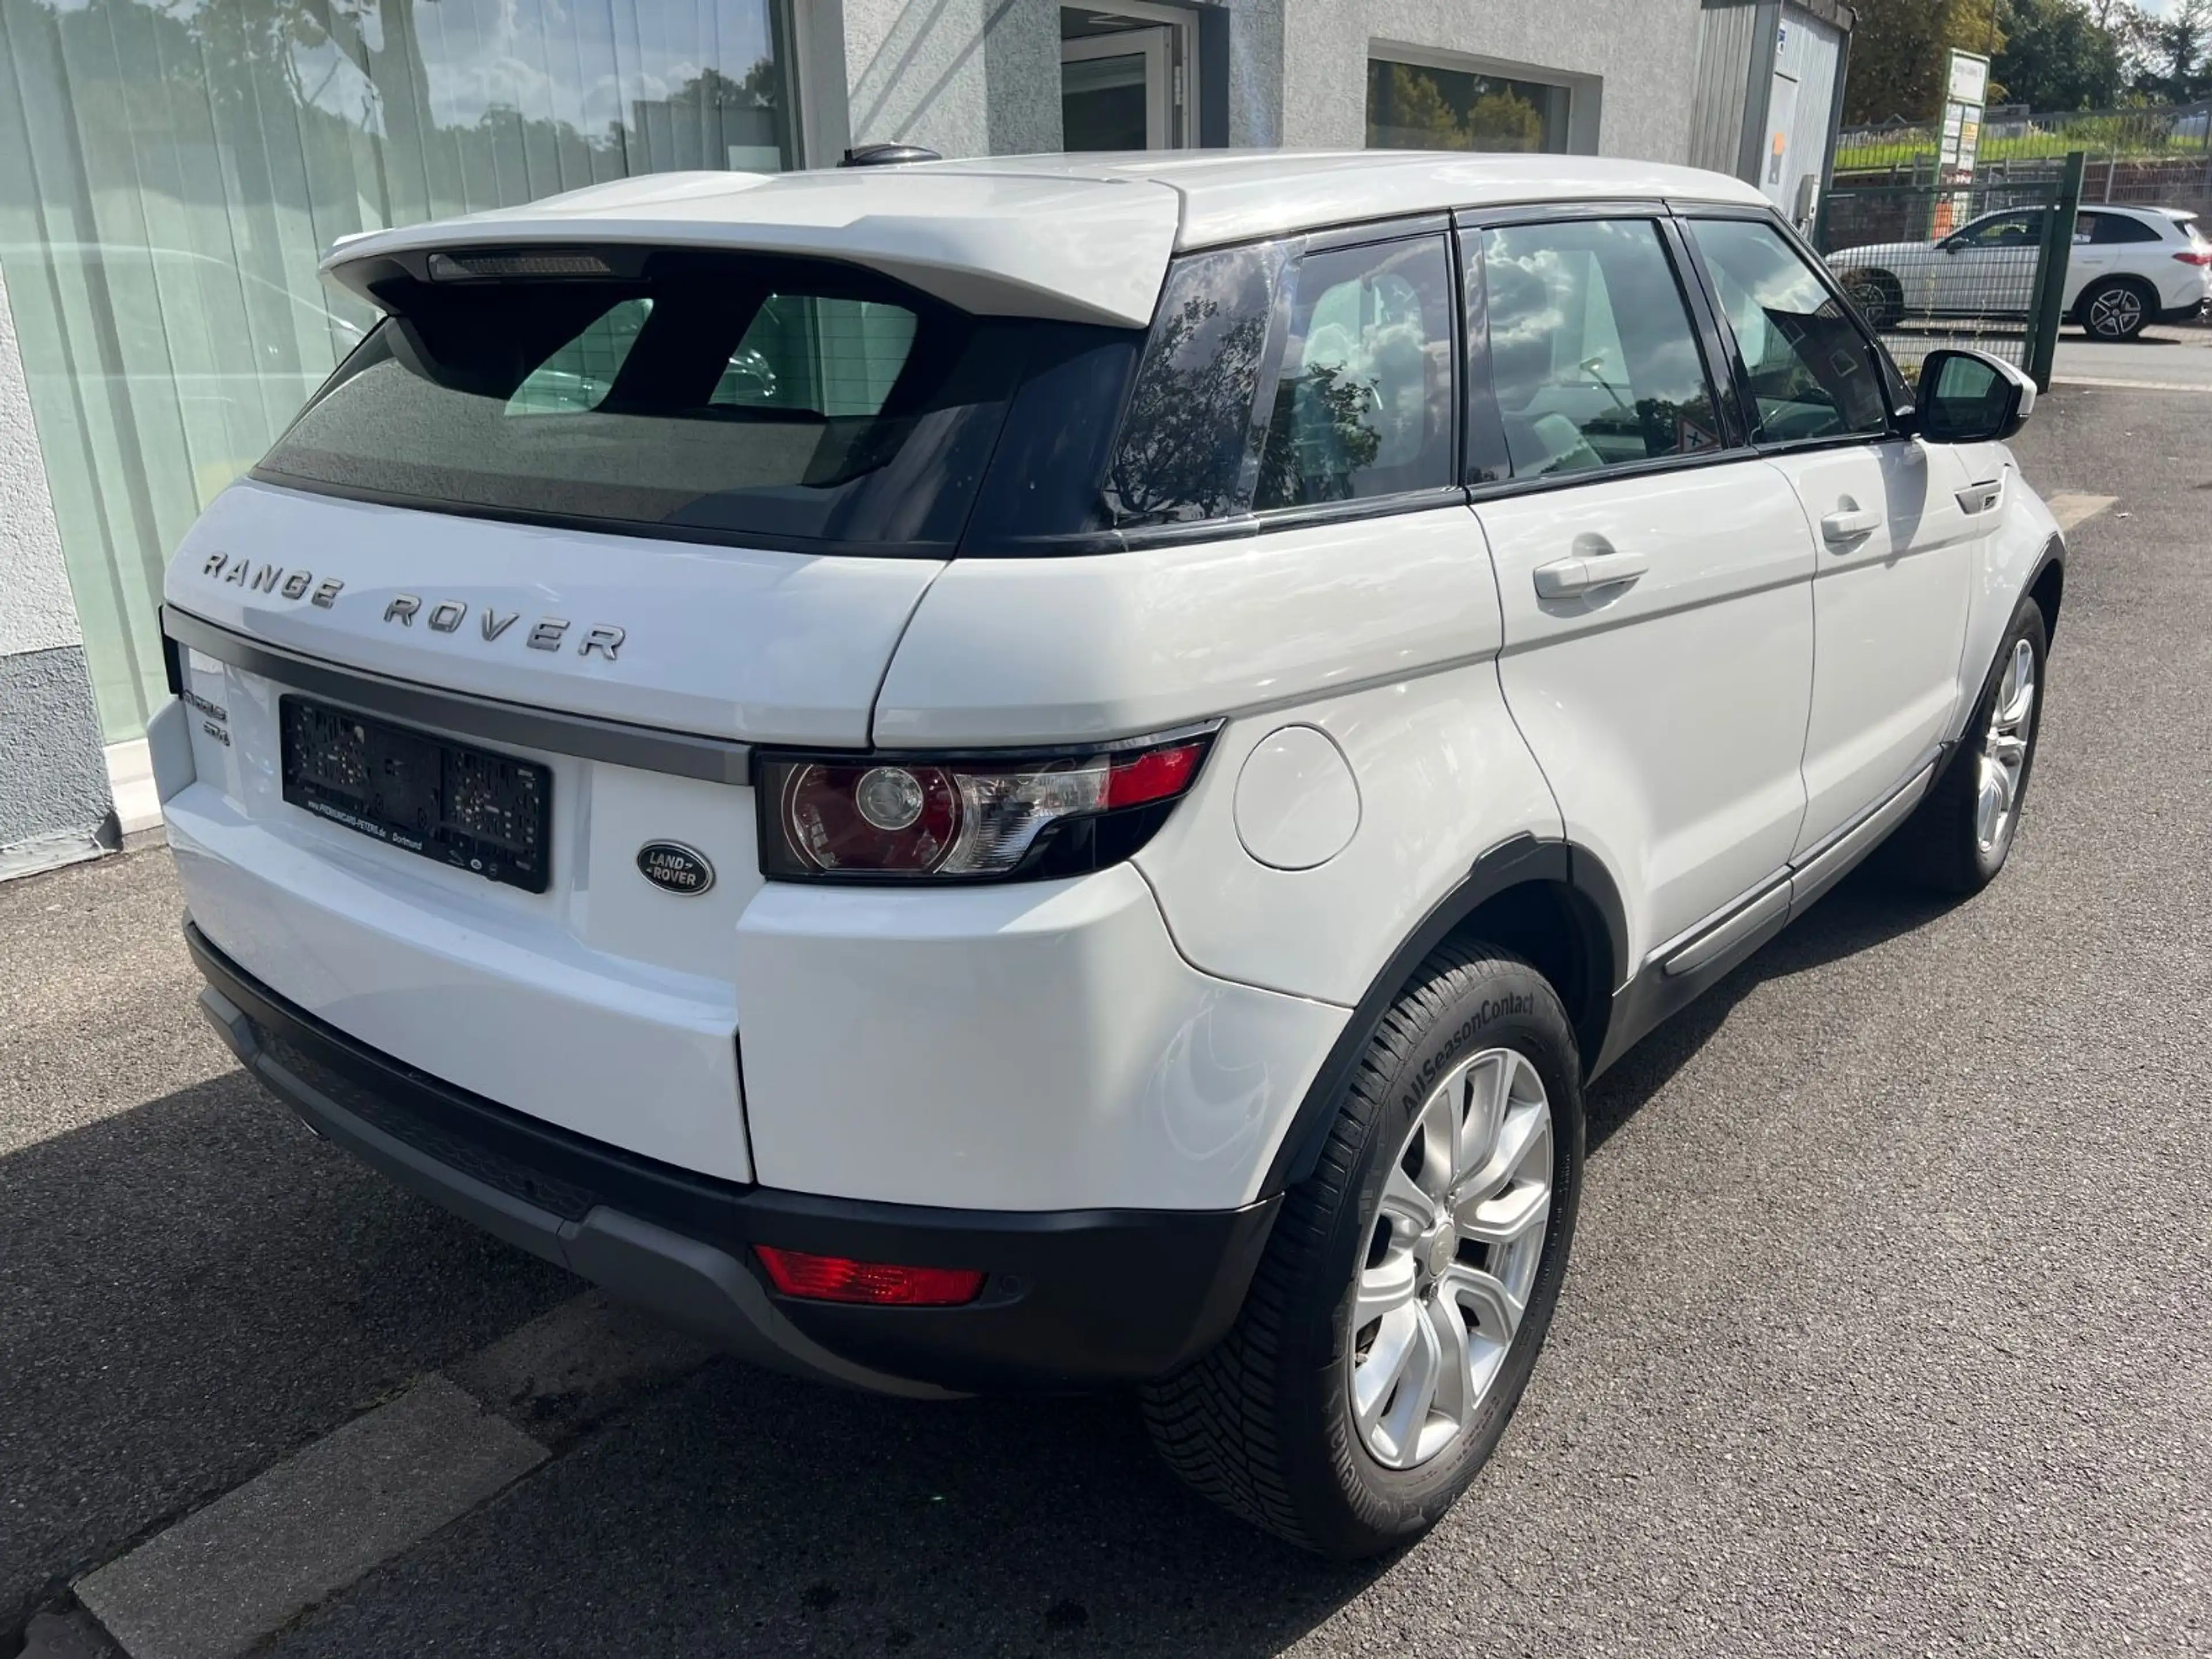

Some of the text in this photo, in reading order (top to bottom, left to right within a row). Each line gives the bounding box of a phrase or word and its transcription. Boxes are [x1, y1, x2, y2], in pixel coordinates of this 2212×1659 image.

[203, 550, 626, 661] RANGE ROVER
[392, 831, 423, 851] Dortmund
[1401, 991, 1535, 1123] AllSeasonContact
